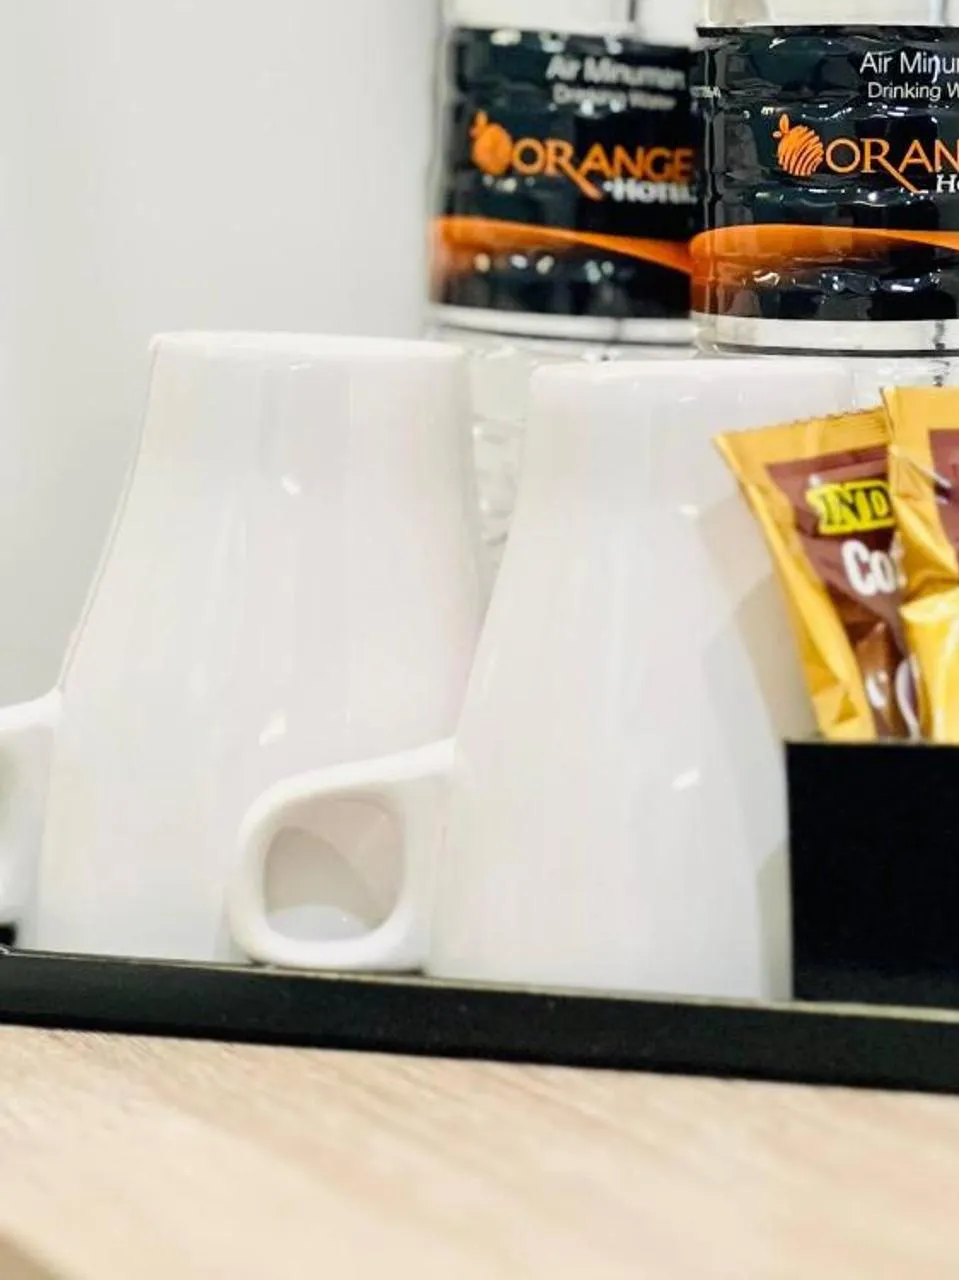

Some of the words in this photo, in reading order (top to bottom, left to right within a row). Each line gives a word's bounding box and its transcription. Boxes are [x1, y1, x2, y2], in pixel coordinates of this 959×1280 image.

[860, 51, 893, 74] Air
[868, 82, 941, 101] Drinking
[512, 137, 697, 200] ORANGE
